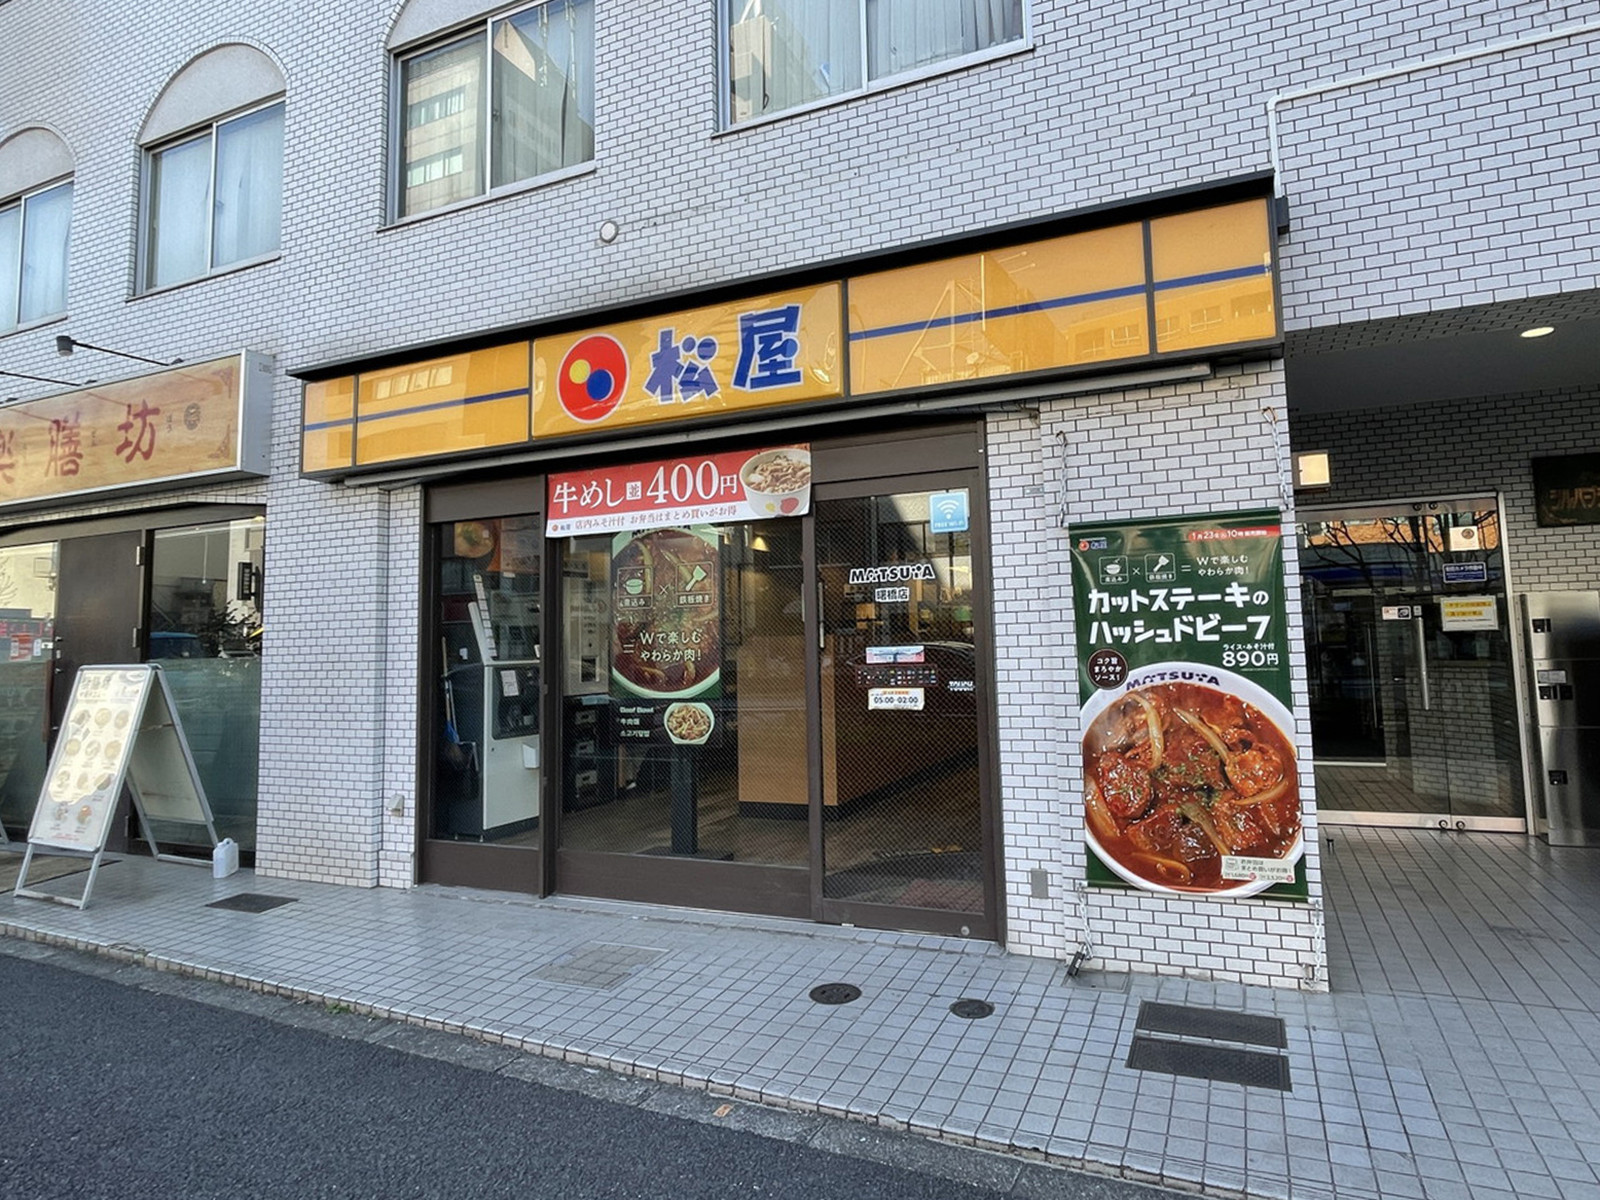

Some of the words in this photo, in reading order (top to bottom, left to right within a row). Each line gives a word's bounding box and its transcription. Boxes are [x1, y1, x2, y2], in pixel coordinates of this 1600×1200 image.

[643, 304, 804, 404] 松屋
[850, 564, 935, 583] MATSUYA
[1088, 582, 1270, 614] カットステーキの
[640, 629, 703, 645] Wで楽しむ
[1089, 613, 1271, 645] ハッシュドビーフ
[1222, 650, 1279, 667] 890円
[1126, 671, 1220, 691] MATSUYA
